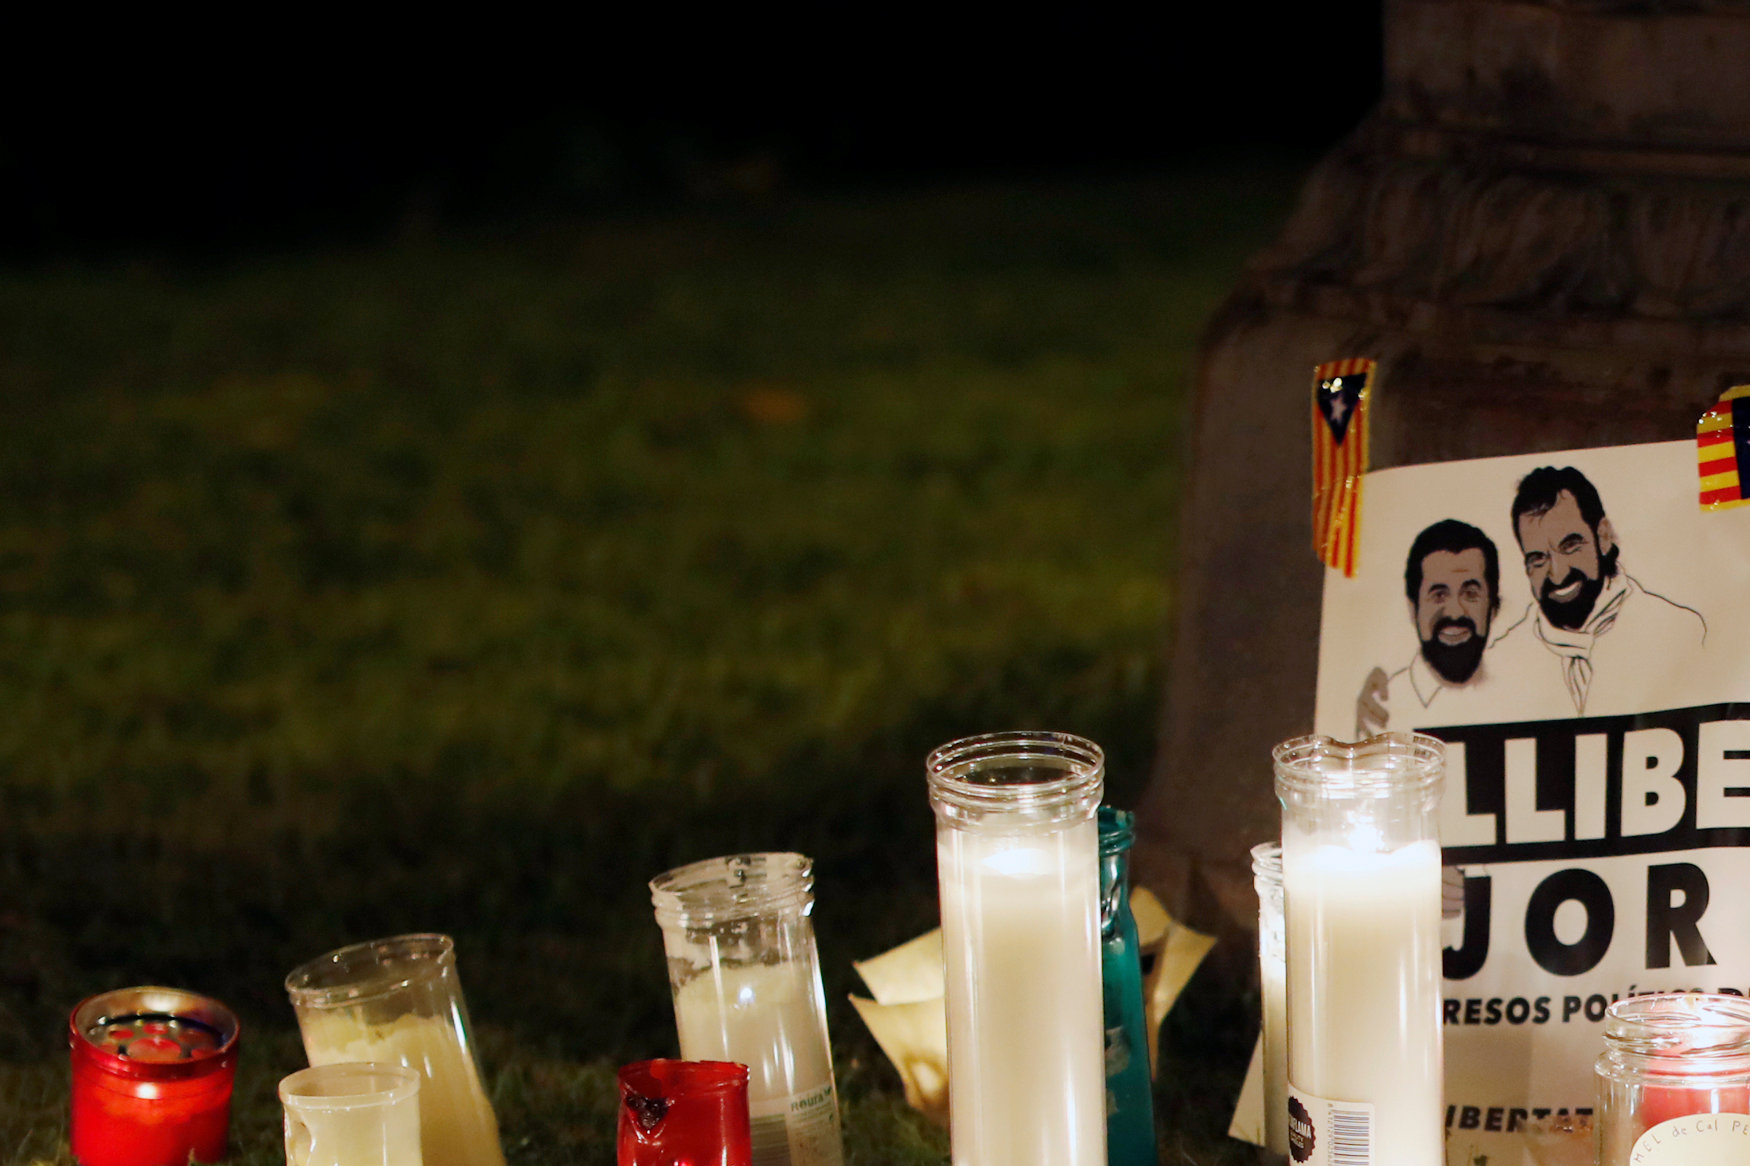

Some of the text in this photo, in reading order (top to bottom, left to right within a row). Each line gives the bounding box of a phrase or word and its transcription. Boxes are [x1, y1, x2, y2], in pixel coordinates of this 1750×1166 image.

[1442, 996, 1552, 1026] RESOS
[1633, 1134, 1662, 1164] MEL
[1671, 1125, 1689, 1138] de
